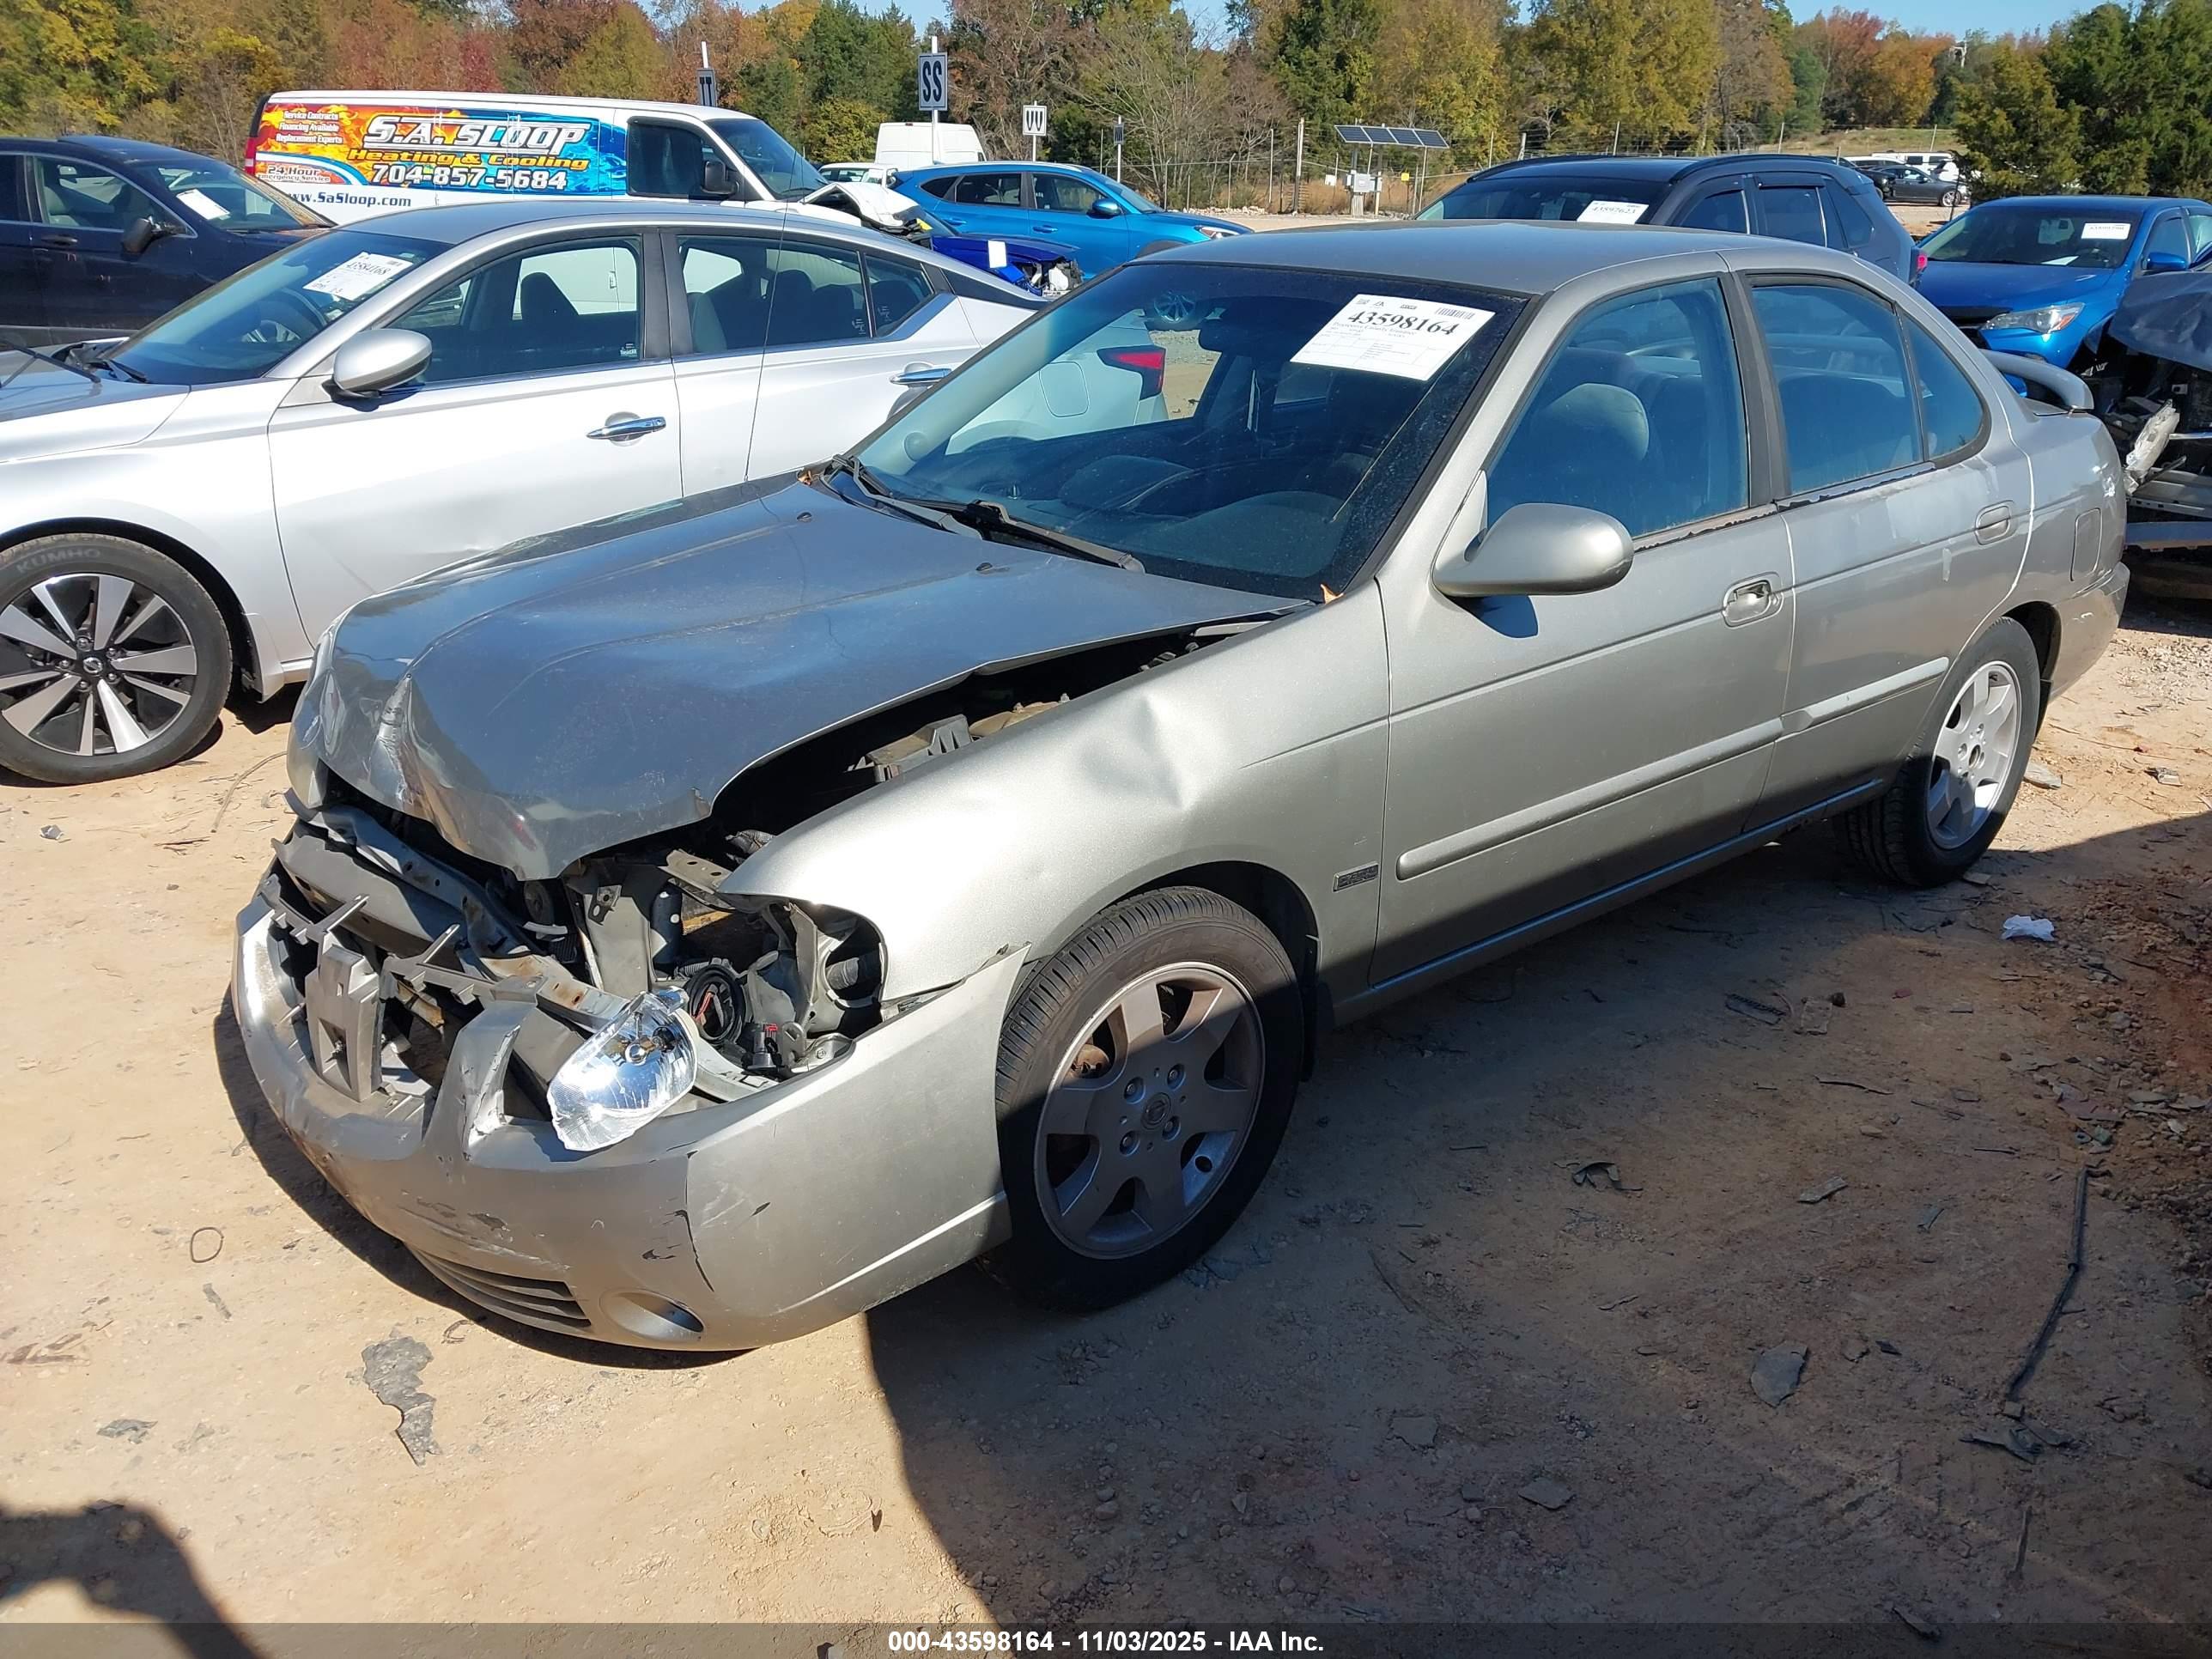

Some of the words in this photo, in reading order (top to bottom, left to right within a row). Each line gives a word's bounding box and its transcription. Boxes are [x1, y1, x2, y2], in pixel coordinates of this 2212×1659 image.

[699, 76, 712, 106] TT
[923, 60, 942, 102] SS
[279, 123, 309, 132] Financing
[310, 123, 340, 131] Available
[307, 112, 339, 120] Contracts
[276, 133, 317, 143] Replacement
[318, 135, 343, 144] Experts
[363, 115, 445, 145] S.A.
[454, 119, 590, 155] SLOOP
[289, 167, 318, 176] Hour
[347, 149, 456, 165] Heating
[461, 154, 481, 164] &
[489, 155, 590, 171] Cooling
[372, 163, 568, 190] 704-857-5684
[289, 191, 411, 207] ww.SaSloop.com
[1348, 311, 1460, 335] 43598164
[16, 549, 100, 573] KUMHO
